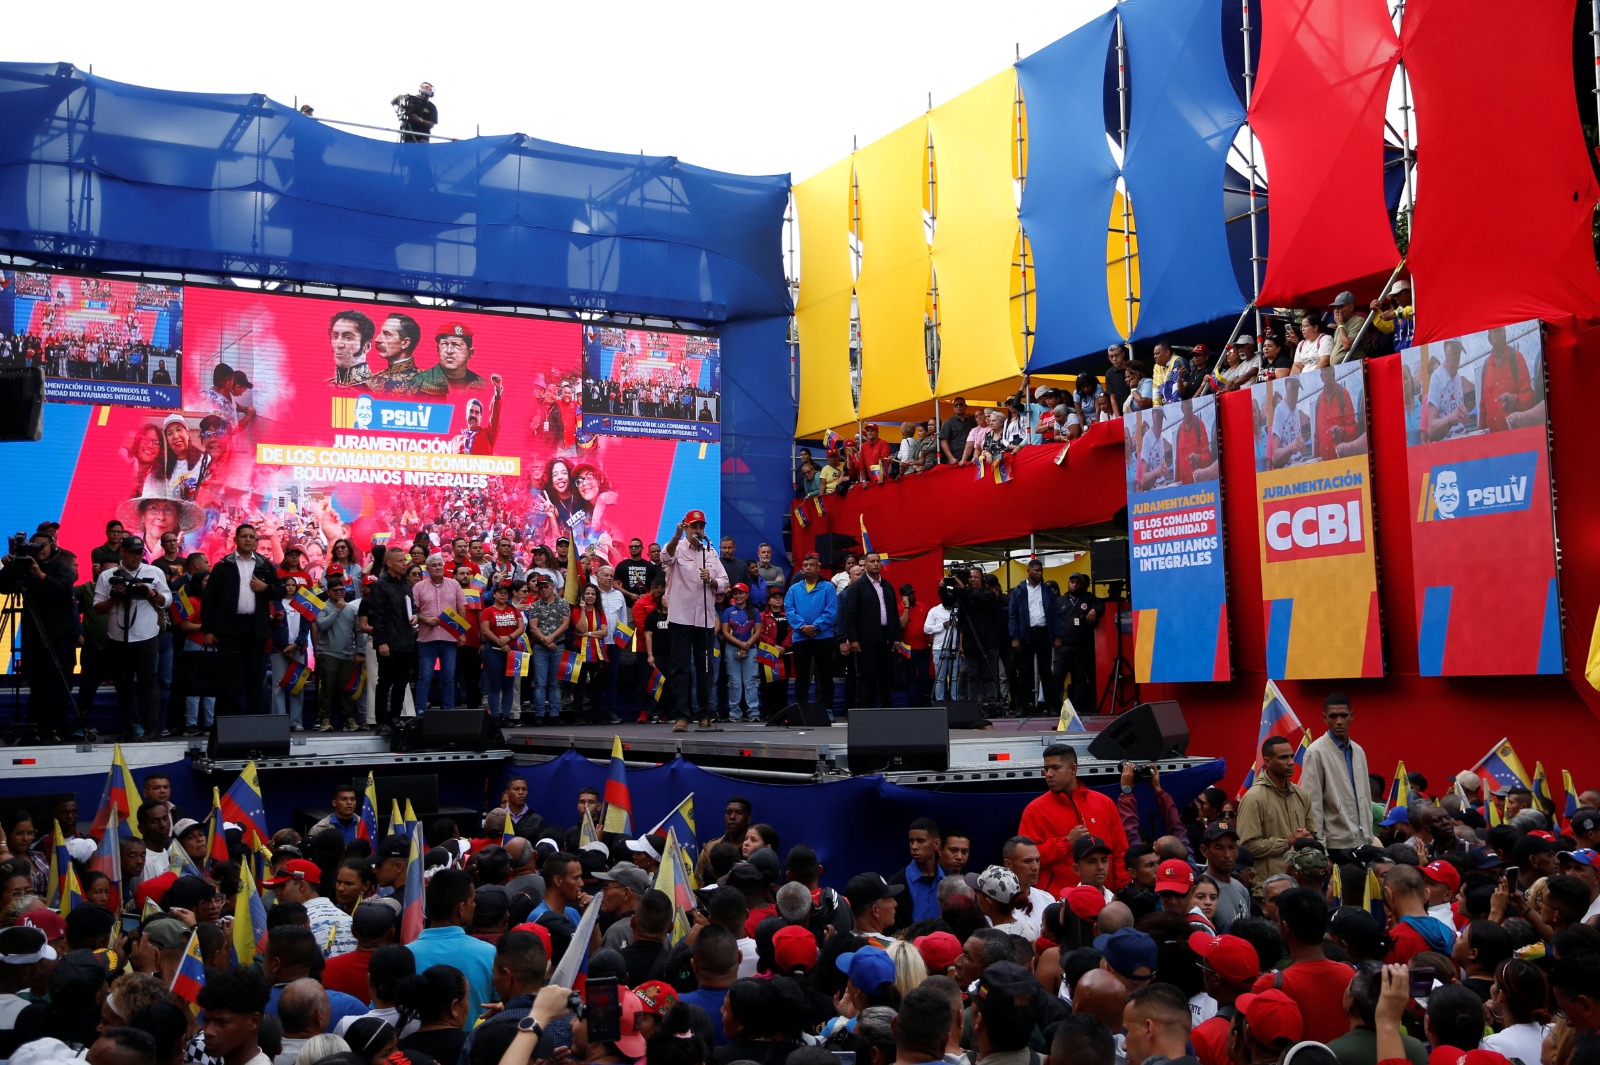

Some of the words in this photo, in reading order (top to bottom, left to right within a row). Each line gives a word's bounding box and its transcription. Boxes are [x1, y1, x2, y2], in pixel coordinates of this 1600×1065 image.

[44, 383, 83, 391] AMENTACIÓN
[69, 391, 113, 399] BOLIVARIANOS
[115, 394, 150, 402] INTEGRALES
[333, 434, 452, 455] JURAMENTACIÓN
[262, 447, 284, 463] DE
[286, 449, 316, 465] LOS
[320, 451, 407, 470] COMANDOS
[410, 454, 428, 470] DE
[431, 457, 515, 473] COMUNIDAD
[294, 466, 401, 485] BOLIVARIANOS
[404, 472, 488, 489] INTEGRALES
[1263, 471, 1362, 499] JURAMENTACIÓN
[1132, 489, 1215, 515] JURAMENTACIÓN
[1133, 520, 1145, 531] DE
[1146, 517, 1162, 529] LOS
[1163, 510, 1215, 526] COMANDOS
[1140, 529, 1152, 540] DE
[1153, 522, 1208, 539] COMUNIDAD
[1266, 500, 1362, 550] CCBI
[1133, 536, 1218, 558] BOLIVARIANOS
[1140, 551, 1212, 571] INTEGRALES
